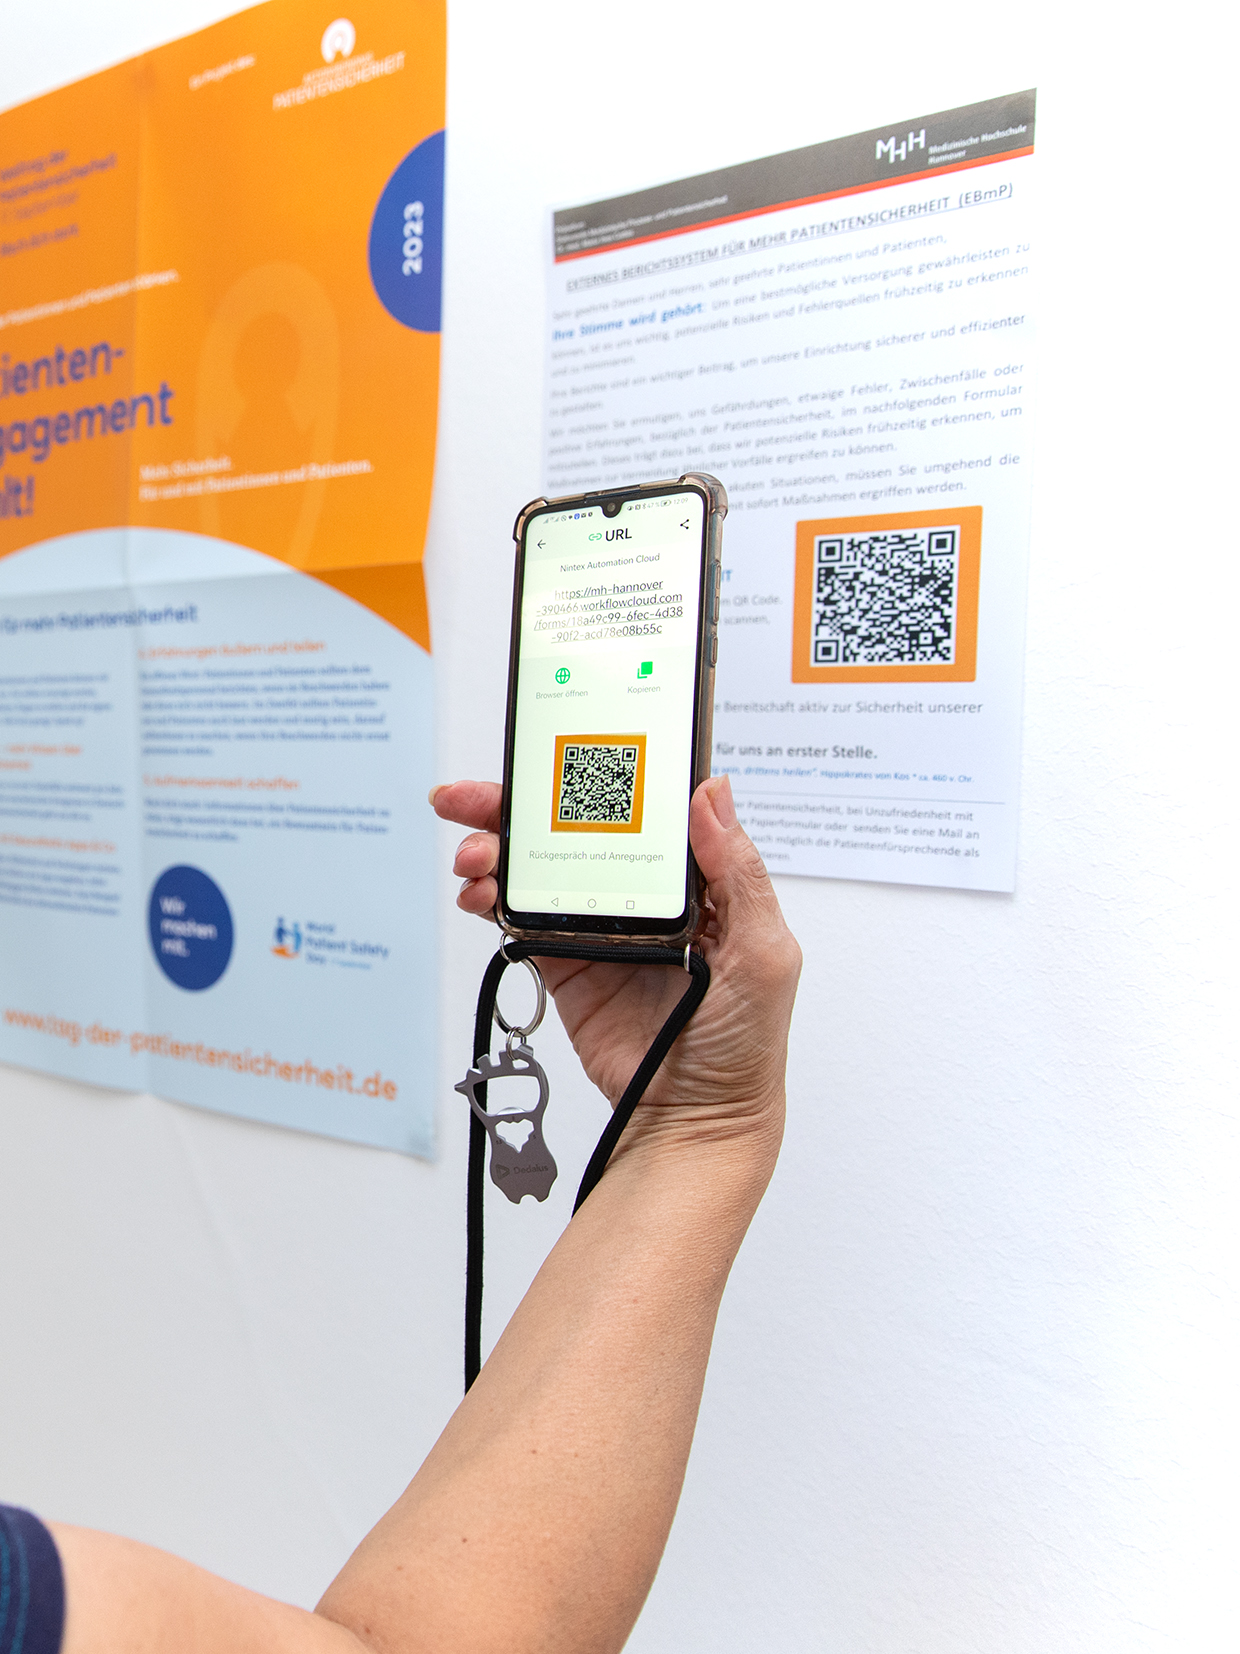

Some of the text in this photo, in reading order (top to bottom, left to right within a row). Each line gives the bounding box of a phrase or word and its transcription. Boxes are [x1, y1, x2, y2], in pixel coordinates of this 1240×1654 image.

[875, 129, 926, 164] MHH
[928, 123, 1027, 155] Medizinische Hochschule
[722, 240, 745, 257] FÜR
[748, 231, 786, 251] MEHR
[791, 196, 950, 240] PATIENTENSICHERHEIT
[959, 182, 1012, 209] (EBmP)
[401, 200, 425, 277] 2023
[777, 252, 852, 274] Patientinnen
[855, 244, 878, 260] und
[882, 234, 947, 254] Patienten,
[580, 320, 623, 336] Stimme
[629, 311, 656, 326] wird
[760, 279, 837, 301] bestmögliche
[842, 264, 913, 286] Versorgung
[918, 247, 1009, 275] gewährleisten
[1016, 243, 1030, 254] zu
[772, 305, 795, 319] und
[798, 293, 880, 315] Fehlerquellen
[884, 280, 943, 300] frühzeitig
[948, 279, 962, 289] zu
[967, 266, 1028, 286] erkennen
[761, 350, 800, 366] unsere
[804, 339, 871, 359] Einrichtung
[875, 331, 926, 348] sicherer
[930, 324, 955, 339] und
[960, 314, 1025, 334] effizienter
[797, 389, 844, 404] etwaige
[850, 383, 892, 396] Fehler,
[899, 368, 987, 390] Zwischenfälle
[993, 363, 1023, 377] oder
[841, 407, 856, 417] im
[862, 394, 956, 415] nachfolgenden
[963, 384, 1023, 402] Formular
[821, 426, 863, 439] Risiken
[867, 418, 927, 434] frühzeitig
[931, 411, 996, 427] erkennen,
[1000, 407, 1022, 418] um
[776, 449, 828, 465] ergreifen
[831, 448, 845, 458] zu
[848, 443, 897, 456] können.
[770, 474, 839, 490] Situationen,
[845, 468, 892, 481] müssen
[898, 464, 917, 477] Sie
[923, 455, 992, 474] umgehend
[999, 453, 1020, 466] die
[782, 492, 856, 506] Maßnahmen
[859, 485, 912, 501] ergriffen
[916, 481, 967, 495] werden.
[605, 528, 632, 542] URL
[560, 553, 660, 573] Nintex Automation Cloud
[554, 580, 663, 601] https://mh-hannover
[536, 593, 683, 617] -390466.workflowcloud.com
[533, 606, 684, 631] /forms/18a49c99-6fec-4d38
[551, 623, 663, 643] -90f2-acd78e08b55c
[535, 689, 589, 700] Browser öffnen
[627, 685, 661, 695] Kopieren
[724, 700, 983, 714] Bereitschaft aktiv zur Sicherheit unserer
[716, 742, 877, 759] für uns an erster Stelle.
[875, 772, 891, 780] von
[894, 772, 909, 781] Kos
[932, 774, 947, 782] 460
[958, 775, 974, 783] Chr.
[847, 806, 863, 816] bei
[866, 807, 951, 821] Unzufriedenheit
[955, 812, 973, 821] mit
[825, 822, 847, 832] oder
[853, 824, 891, 835] senden
[894, 824, 908, 836] Sie
[912, 826, 935, 837] eine
[938, 827, 962, 838] Mail
[966, 831, 979, 840] an
[529, 850, 664, 863] Rückgespräch und Anregungen
[816, 838, 831, 848] die
[834, 838, 960, 857] Patientenfürsprechende
[964, 847, 979, 858] als
[161, 896, 186, 915] Wir
[161, 917, 218, 940] machen
[3, 1006, 397, 1102] www.tag-der-patientensicherheit.de
[513, 1163, 549, 1175] Dedalus
